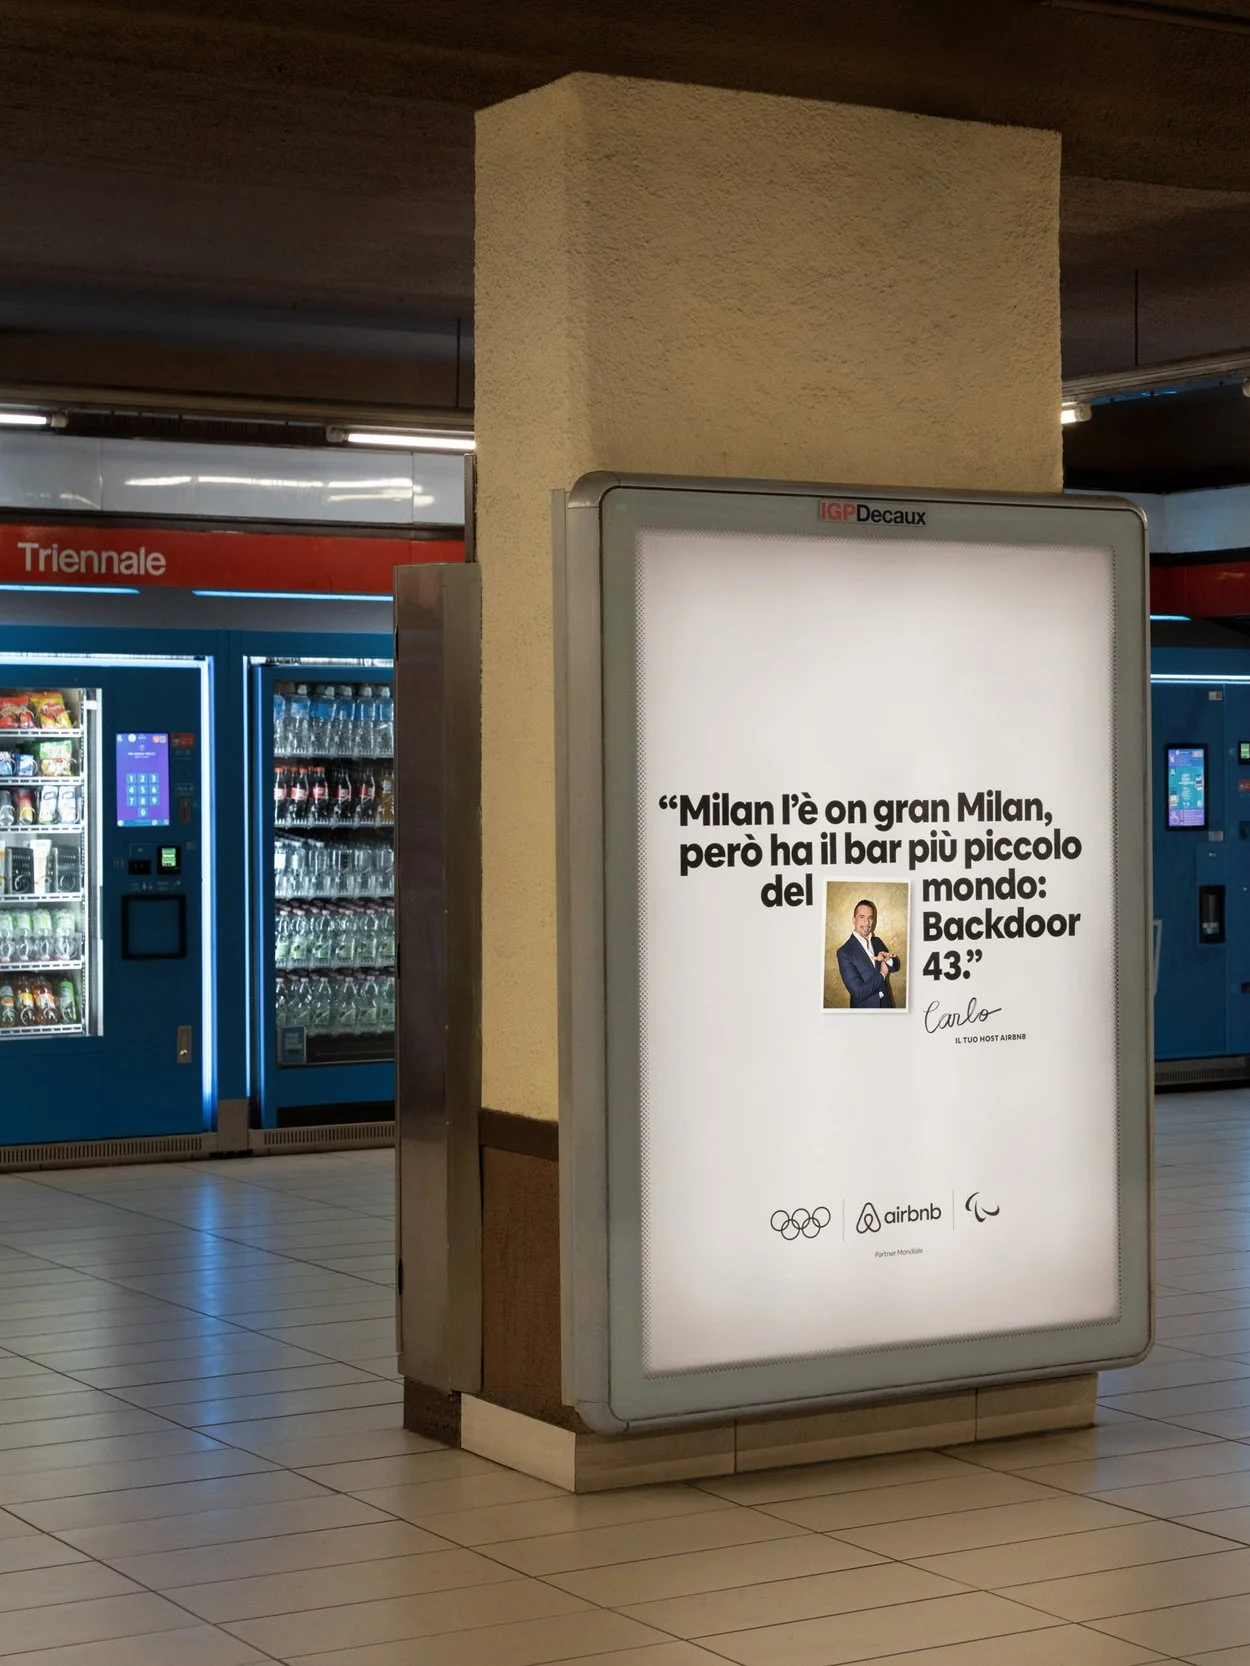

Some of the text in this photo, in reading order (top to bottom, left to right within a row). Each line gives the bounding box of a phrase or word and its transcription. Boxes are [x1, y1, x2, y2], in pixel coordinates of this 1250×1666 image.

[821, 502, 926, 525] IGPDecaux
[17, 542, 166, 576] Triennale
[658, 792, 775, 827] “Milan
[825, 800, 867, 825] on
[873, 799, 950, 832] gran
[957, 789, 1053, 827] Milan,
[680, 828, 1082, 876] però ha il bar più piccolo
[761, 868, 1047, 908] del mondo:
[922, 907, 1081, 942] Backdoor
[922, 949, 983, 981] 43.”
[923, 997, 1002, 1034] Carlo
[884, 1203, 942, 1224] airbnb
[875, 1247, 924, 1258] Partner Mondiale
